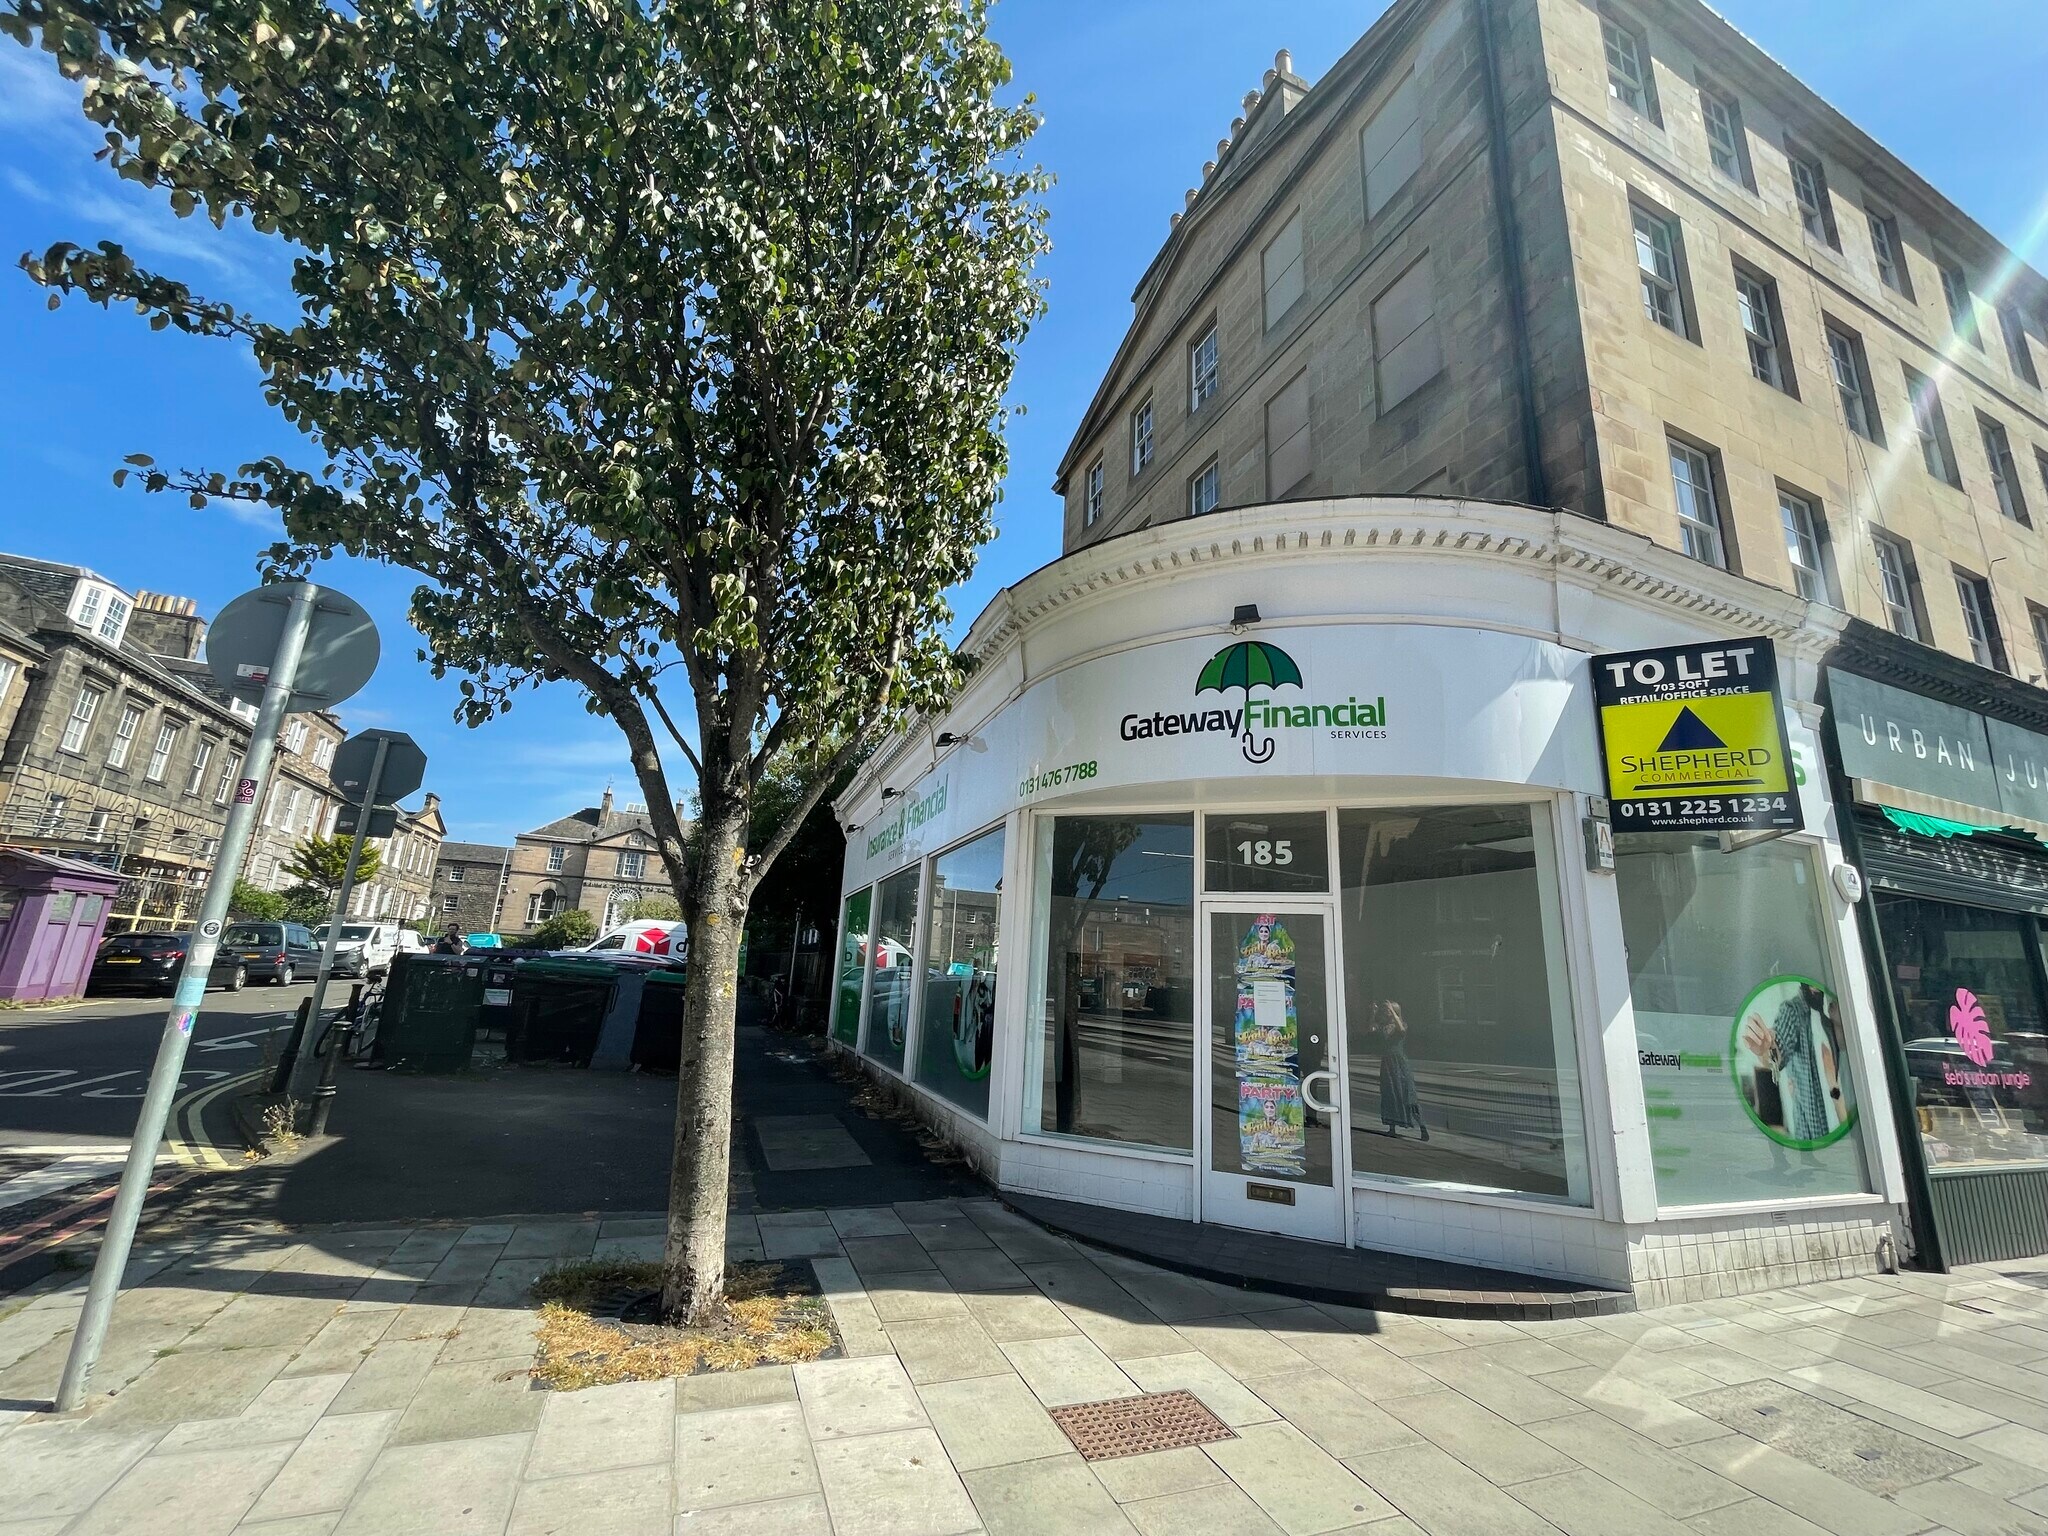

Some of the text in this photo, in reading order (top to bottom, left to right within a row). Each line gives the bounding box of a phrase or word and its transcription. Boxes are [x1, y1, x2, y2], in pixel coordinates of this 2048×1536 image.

[1606, 648, 1754, 688] TO LET
[1620, 686, 1750, 705] RETAIL/OFFICE SPACE
[1653, 679, 1710, 692] 703 SQFT
[1120, 696, 1386, 741] Gateway Financial
[1330, 730, 1387, 739] SERVICES
[1860, 713, 1976, 772] URBAN
[1620, 748, 1771, 774] SHEPHERD
[1020, 760, 1098, 797] 0131 476 7788
[1640, 768, 1754, 782] COMMERCIAL
[906, 773, 949, 835] Financial
[1620, 797, 1787, 818] 0131 225 1234
[1652, 814, 1755, 826] www.shepherd.co.uk
[1237, 840, 1293, 865] 185
[1638, 1050, 1681, 1071] Gateway
[1240, 1086, 1300, 1101] PARTY!
[1115, 1416, 1165, 1432] CATV
